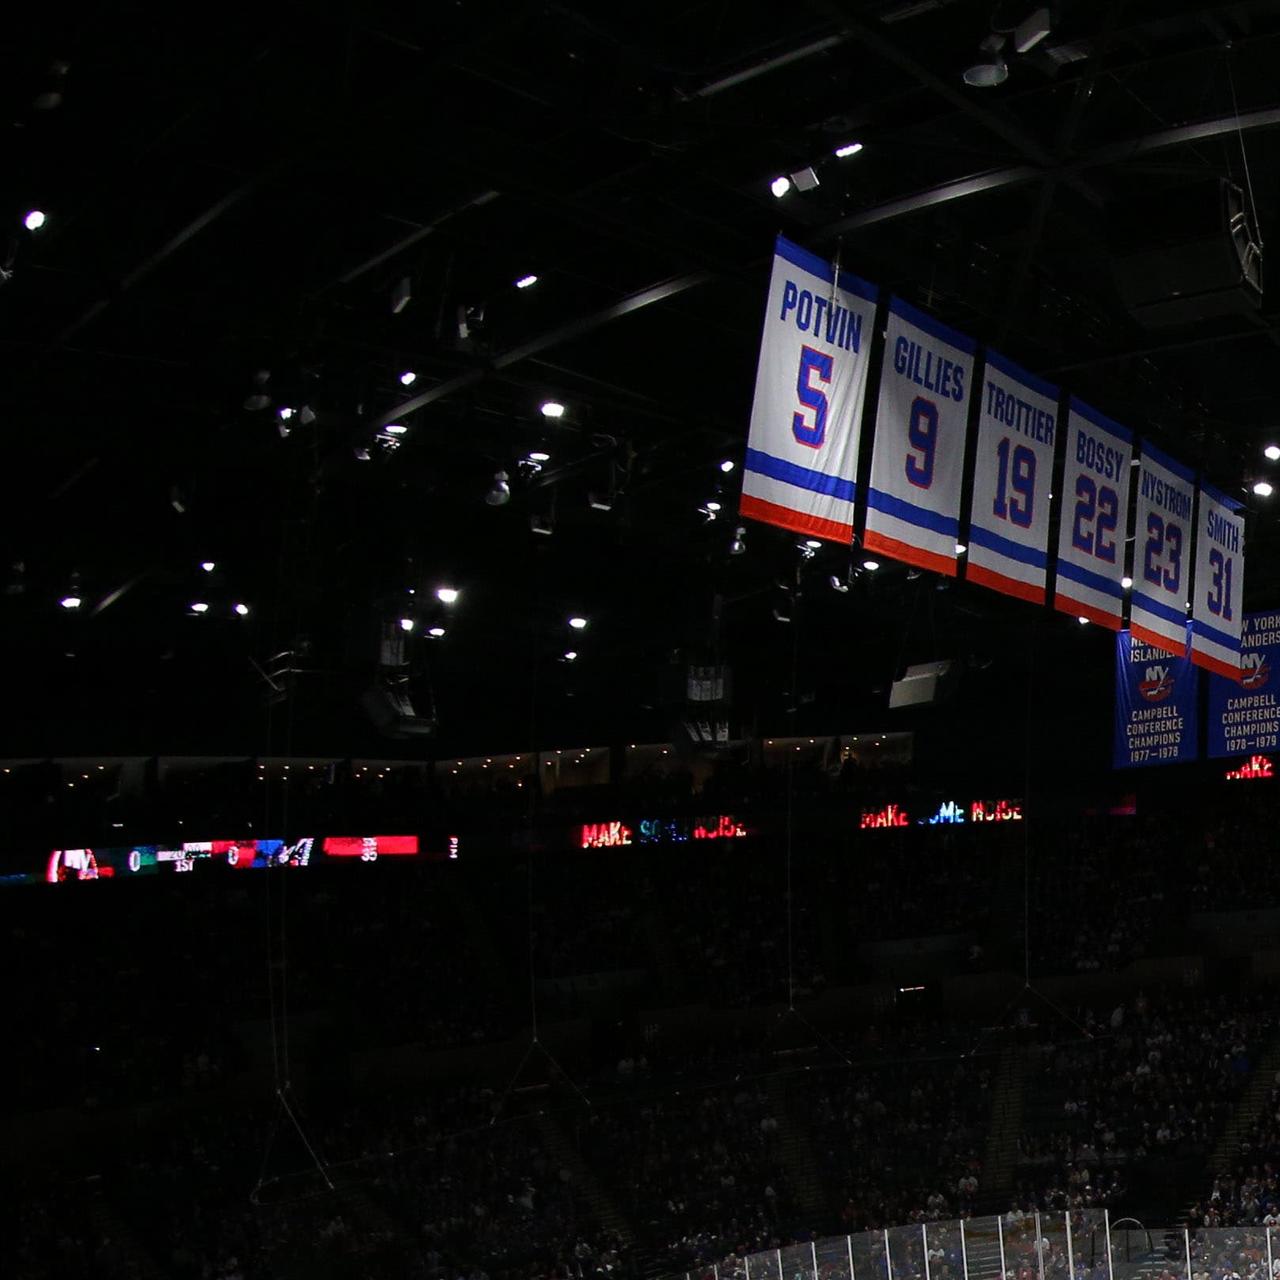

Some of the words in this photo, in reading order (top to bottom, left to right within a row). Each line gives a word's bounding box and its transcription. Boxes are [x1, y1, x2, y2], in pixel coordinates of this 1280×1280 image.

[781, 280, 862, 354] POTVIN
[894, 336, 964, 402] GILLIES
[792, 344, 834, 450] 5
[987, 381, 1054, 446] TROTTIER
[905, 396, 939, 489] 9
[1076, 430, 1124, 483] BOSSY
[993, 436, 1036, 529] 19
[1141, 469, 1191, 521] NYSTROM
[1072, 474, 1118, 564] 22
[1207, 510, 1239, 553] SMITH
[1144, 512, 1183, 595] 23
[1207, 547, 1233, 622] 31
[1126, 718, 1183, 736] CONFERENCE
[1132, 705, 1178, 721] CAMPBELL
[1227, 694, 1277, 709] CAMPBELL
[1129, 732, 1181, 749] CHAMPIONS
[1224, 721, 1280, 738] CHAMPIONS
[582, 821, 632, 848] MAKE
[860, 804, 908, 829] MAKE
[971, 798, 1022, 822] NOISE
[448, 836, 459, 859] PIM
